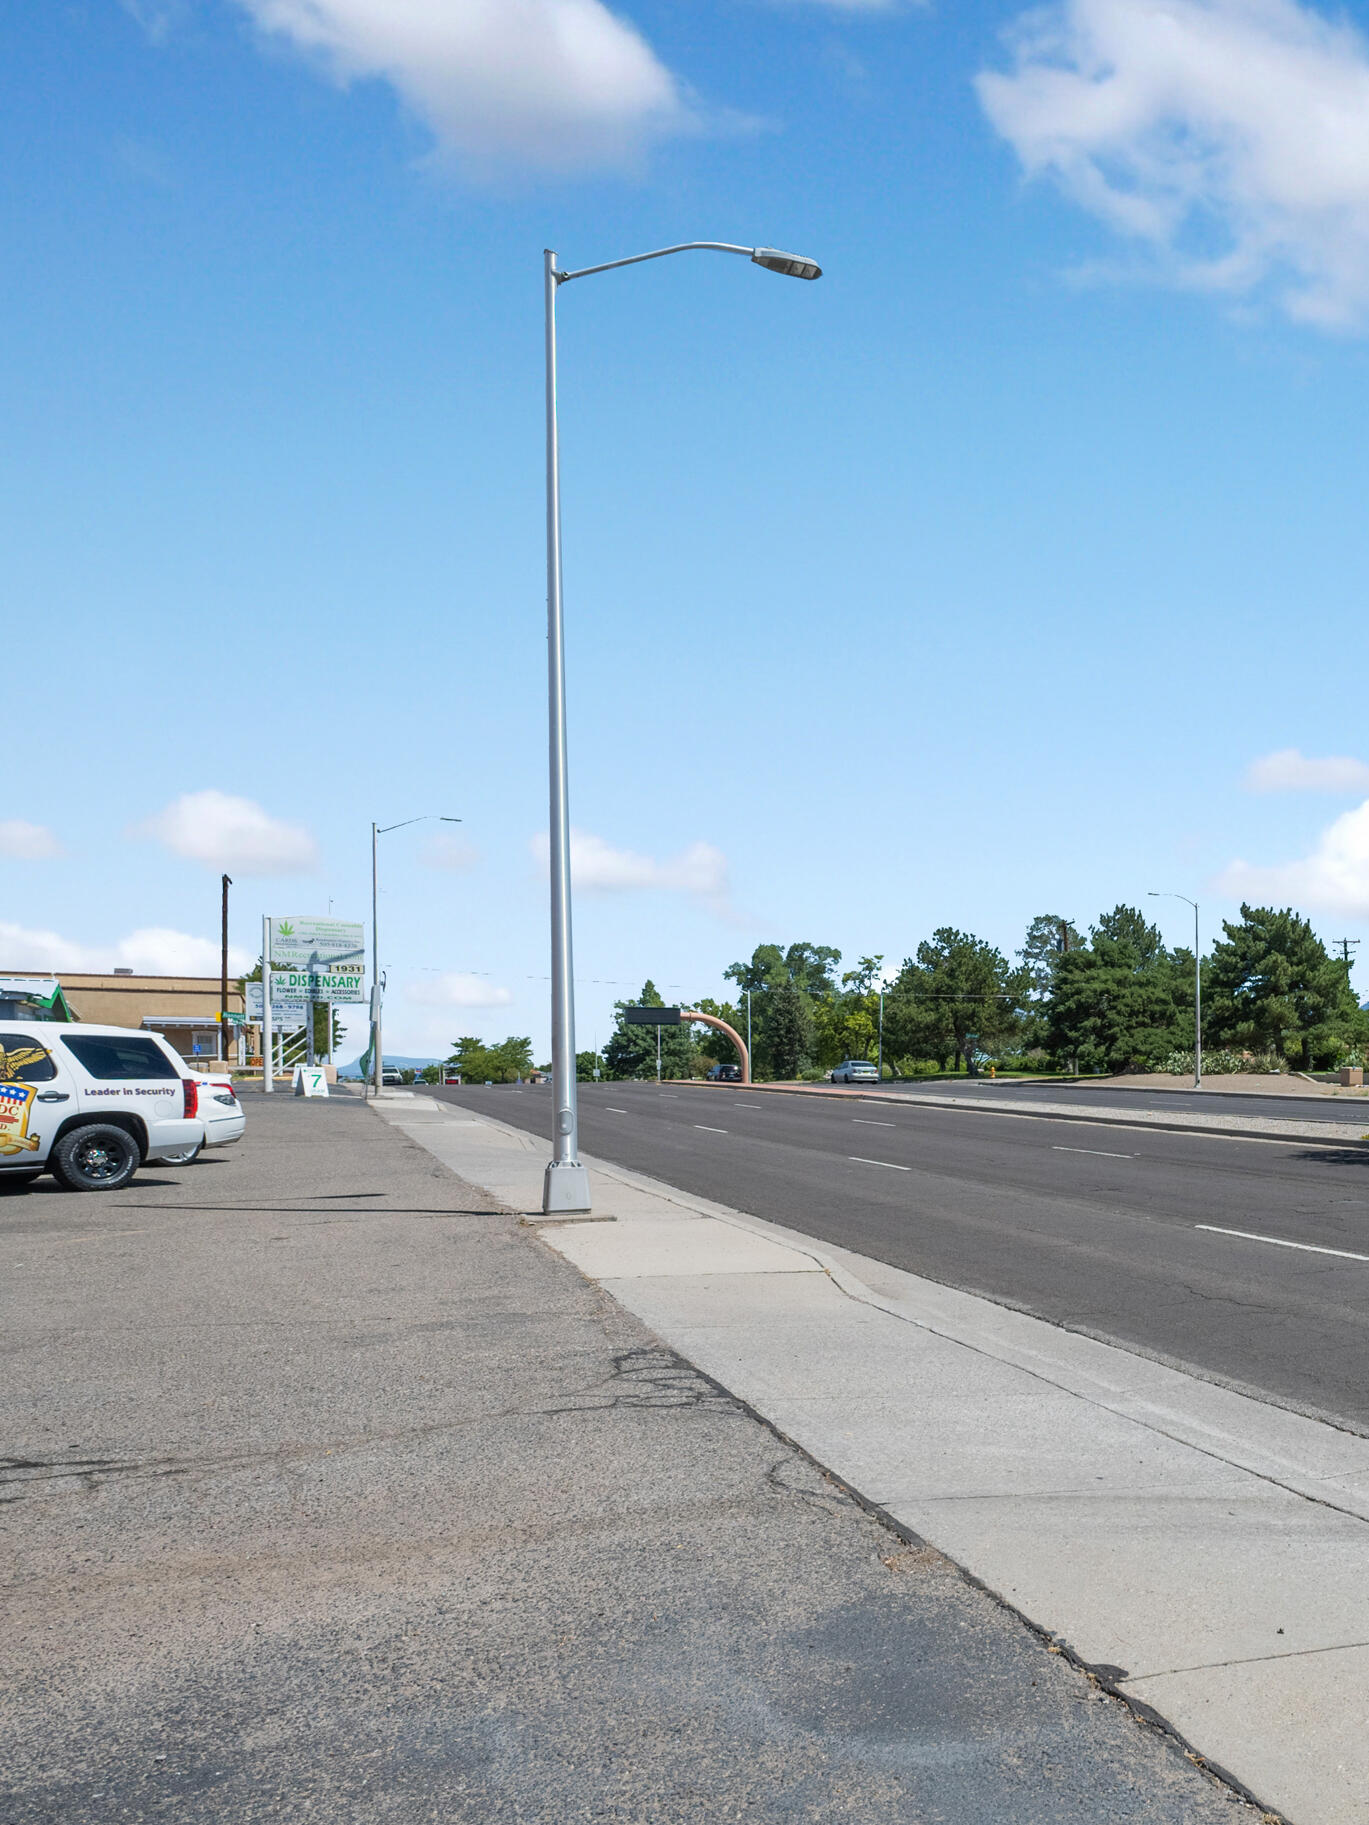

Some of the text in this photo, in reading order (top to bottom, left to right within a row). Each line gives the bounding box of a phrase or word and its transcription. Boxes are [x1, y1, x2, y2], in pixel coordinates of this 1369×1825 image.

[289, 974, 361, 988] DISPENSARY
[251, 1058, 264, 1066] OPE
[311, 1074, 322, 1088] 7
[84, 1087, 176, 1097] Leader in Security
